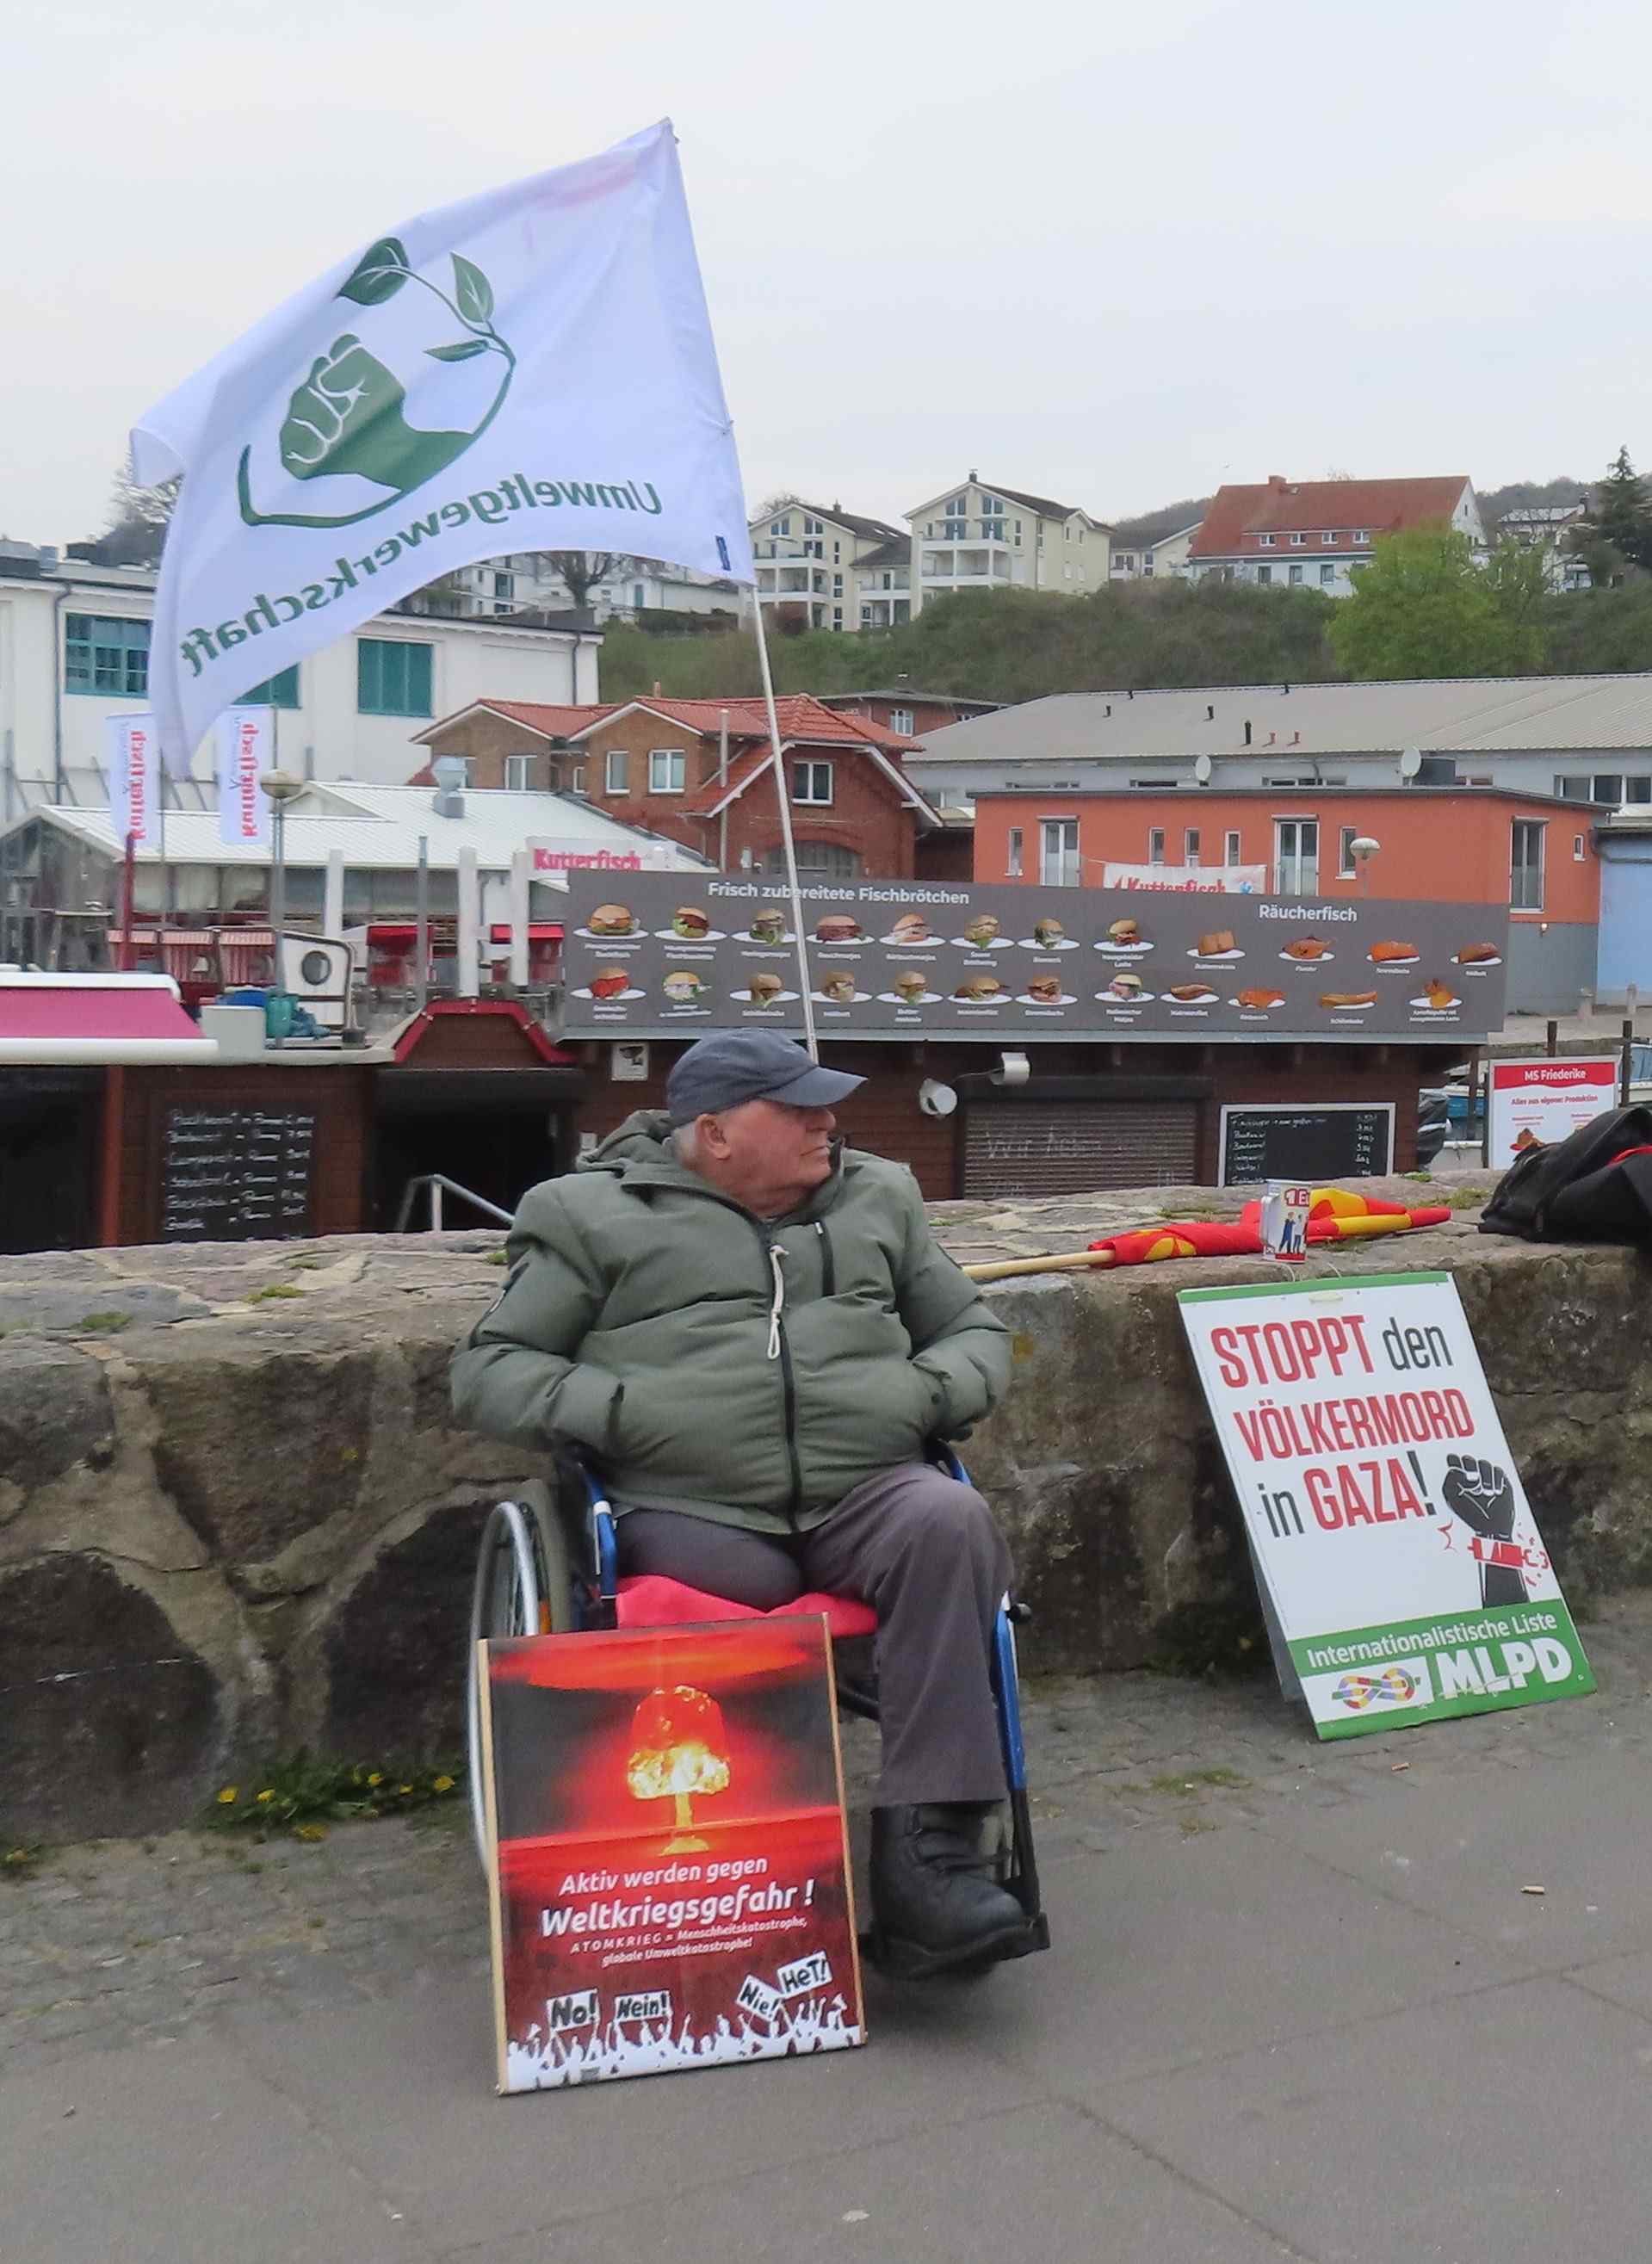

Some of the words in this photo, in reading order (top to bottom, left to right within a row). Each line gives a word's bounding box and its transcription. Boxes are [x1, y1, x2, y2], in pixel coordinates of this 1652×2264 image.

[533, 849, 641, 871] Kutterfisch
[708, 881, 758, 898] Frisch
[859, 887, 970, 906] Fischbrötchen
[1259, 904, 1358, 922] Räucherfisch
[1524, 1069, 1540, 1081] MS
[1541, 1067, 1587, 1080] Friederike
[1210, 1314, 1375, 1389] STOPPT
[1382, 1317, 1454, 1372] den
[1232, 1388, 1476, 1463] VÖLKERMORD
[1257, 1483, 1305, 1538] in
[1302, 1450, 1438, 1531] GAZA!
[1307, 1620, 1511, 1669] Internationalistische
[1513, 1612, 1558, 1635] Liste
[1436, 1636, 1574, 1699] MLPD
[558, 1867, 618, 1897] Aktiv
[622, 1861, 702, 1890] werden
[704, 1858, 768, 1884] gegen
[541, 1883, 798, 1938] Weltkriegsgefahr
[570, 1933, 662, 1955] ATOMKRIEG
[602, 1951, 644, 1968] globale
[645, 1937, 753, 1960] Umweltkatastrophe!
[550, 1991, 597, 2027] No!
[616, 1993, 668, 2020] Nein!
[739, 1983, 779, 2019] Nie!
